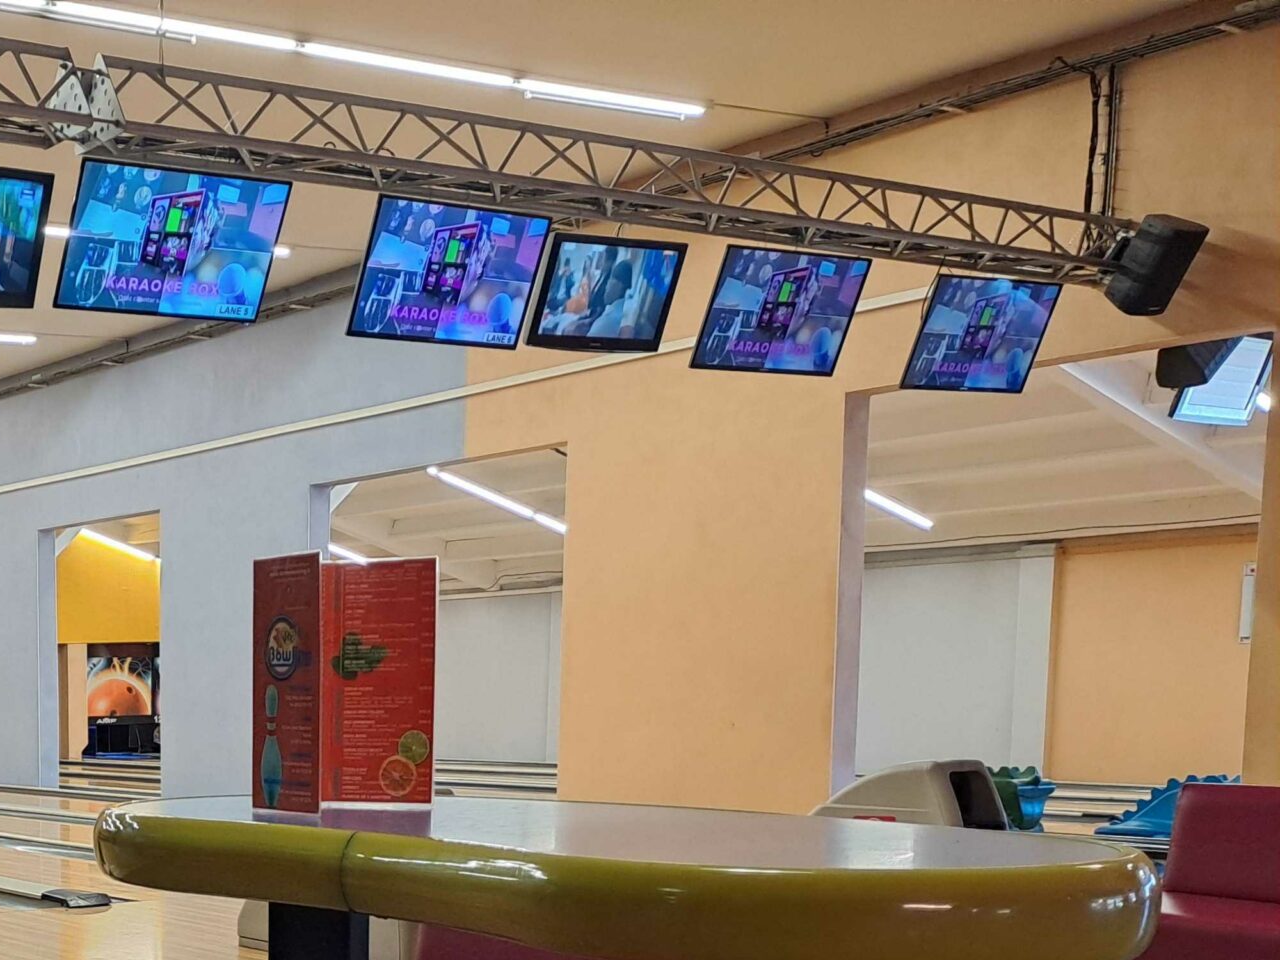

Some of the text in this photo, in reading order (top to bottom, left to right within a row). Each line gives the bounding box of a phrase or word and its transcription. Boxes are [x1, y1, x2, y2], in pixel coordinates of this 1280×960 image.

[105, 275, 183, 294] KARAOKE
[219, 305, 241, 316] LANE
[486, 333, 506, 344] LANE
